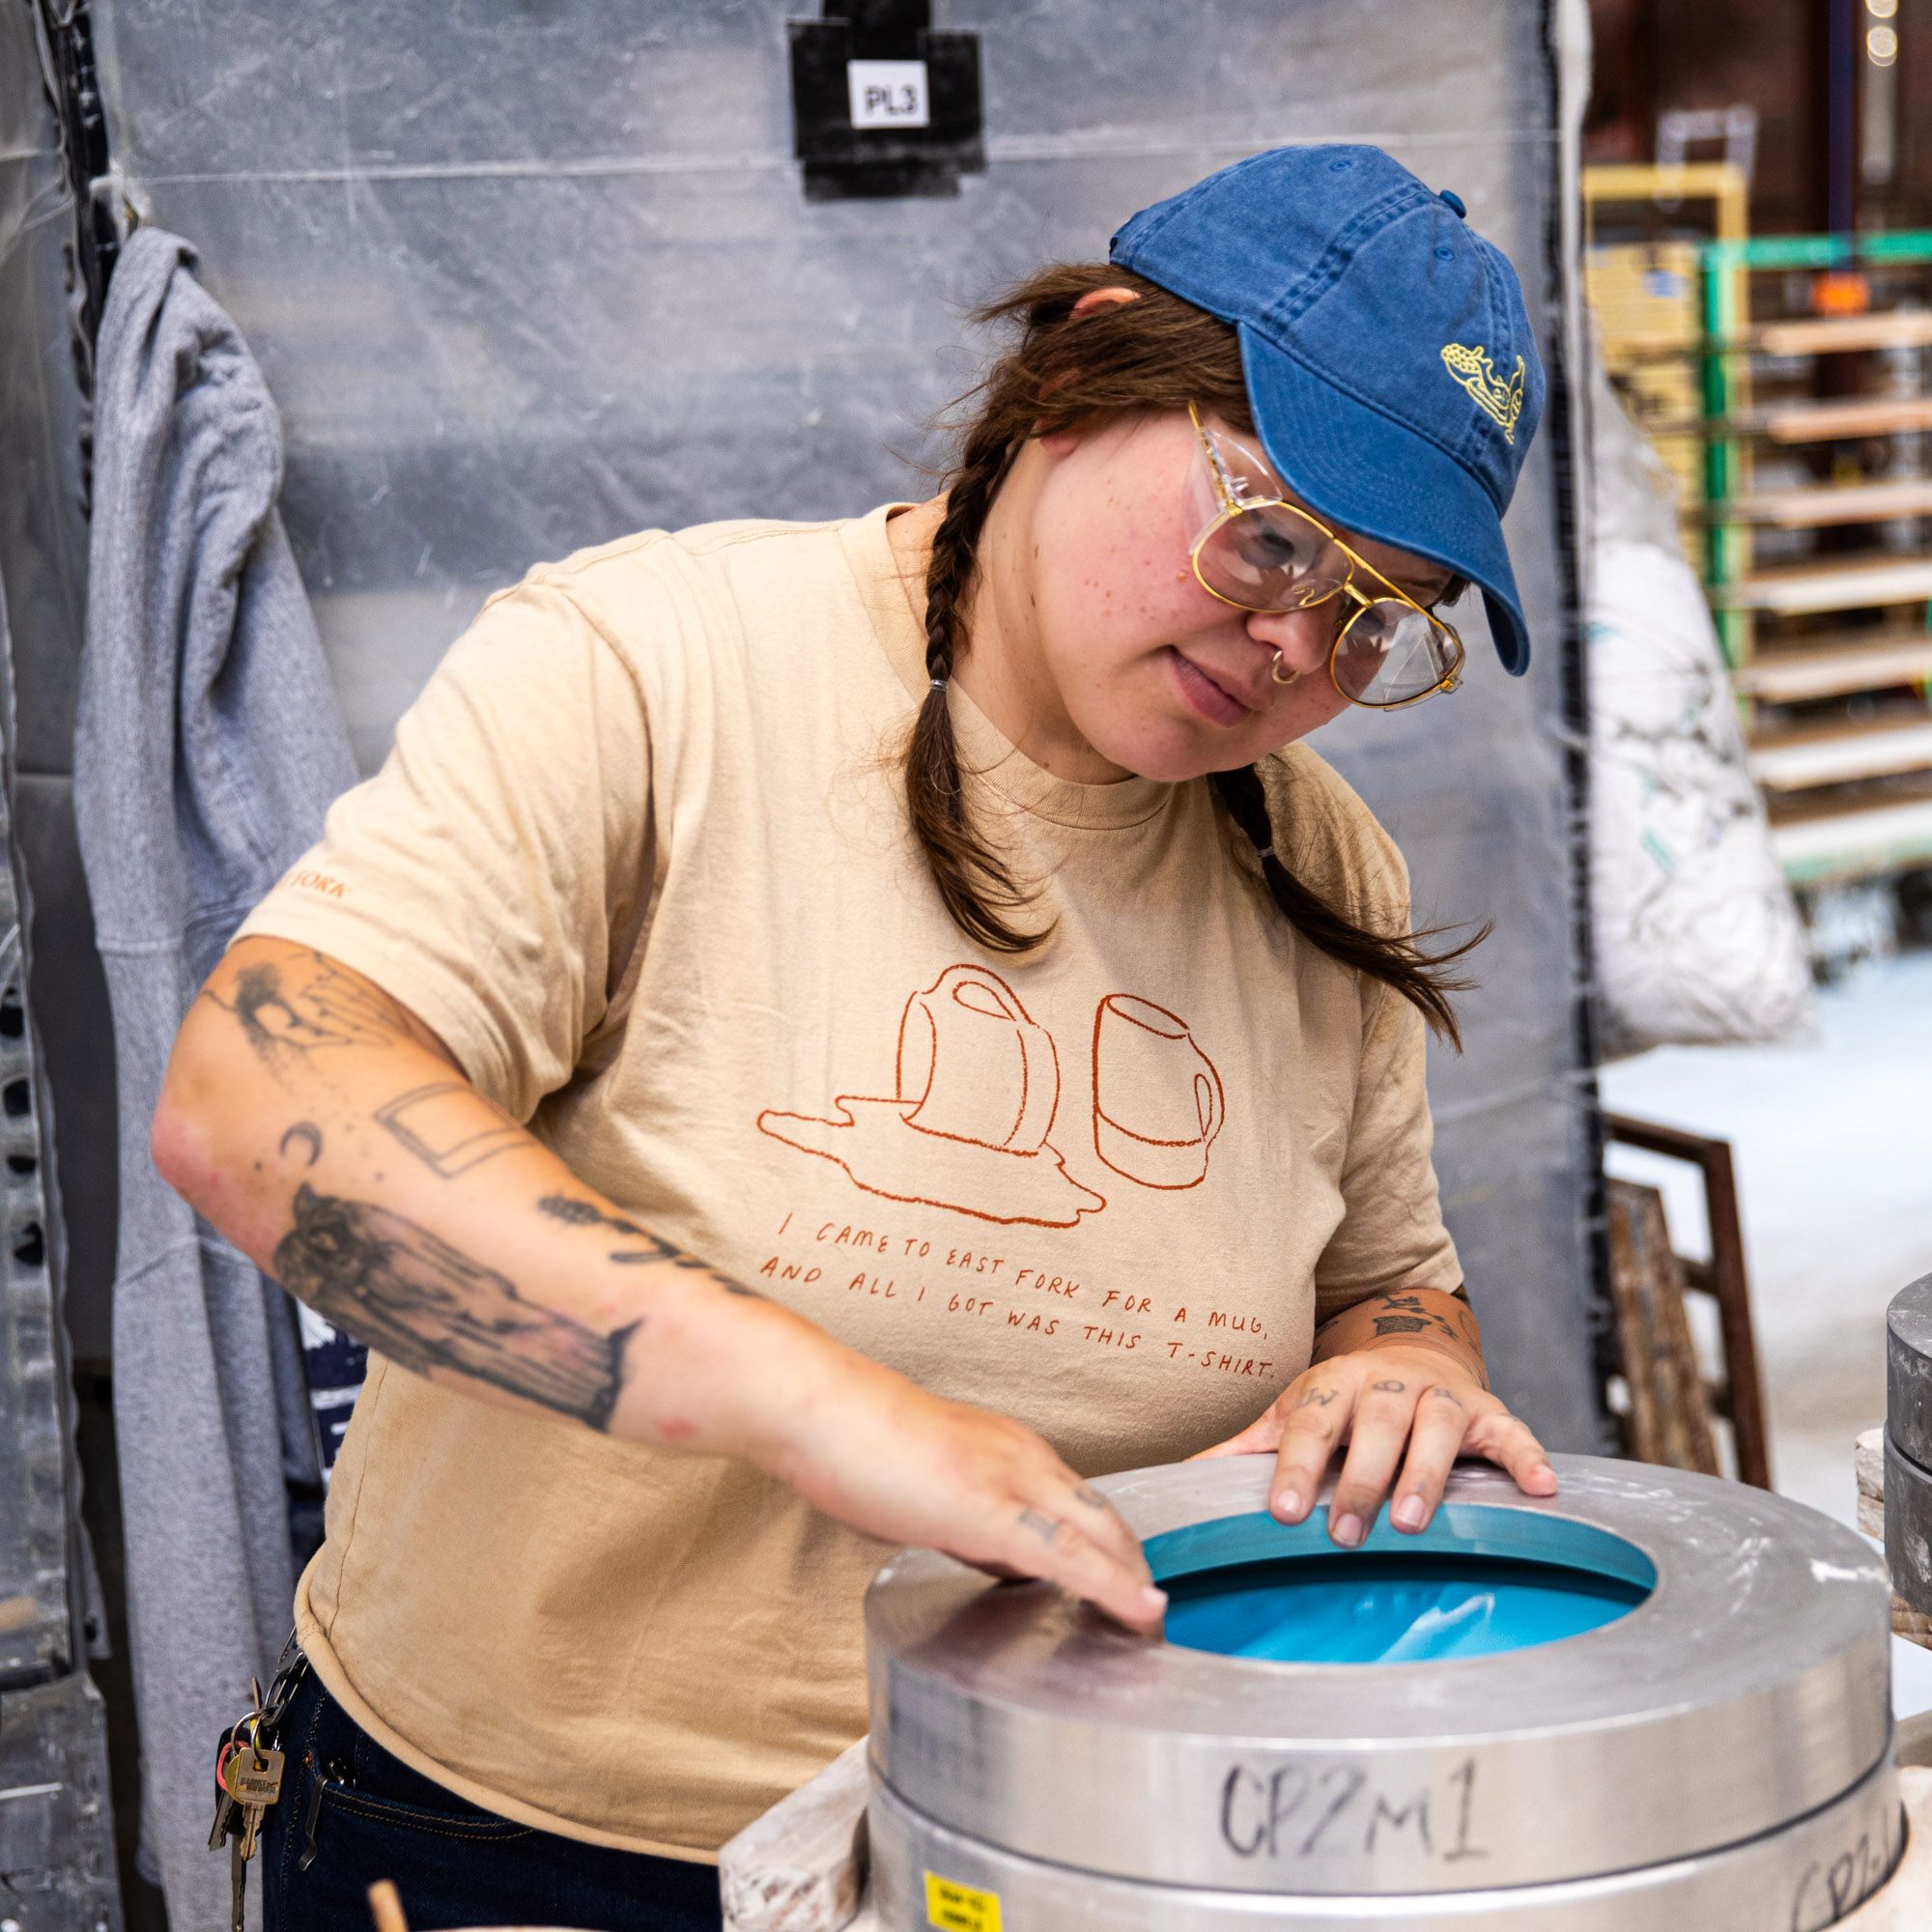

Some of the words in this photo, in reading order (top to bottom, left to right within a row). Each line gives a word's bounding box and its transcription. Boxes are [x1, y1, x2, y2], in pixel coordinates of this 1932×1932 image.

[865, 84, 918, 116] PL3
[759, 1256, 823, 1284] AND
[848, 1271, 896, 1298] ALL
[917, 1286, 926, 1303] I
[948, 1293, 994, 1317] GOT
[1007, 1310, 1060, 1336] WAS
[1083, 1324, 1142, 1350] THIS
[1167, 1342, 1274, 1379] T-SHIRT.
[778, 1210, 794, 1236] I
[815, 1222, 890, 1254] CAME
[904, 1237, 931, 1258] TO
[946, 1249, 1006, 1274] EAST
[1015, 1268, 1080, 1298] FORK
[1102, 1290, 1152, 1314] FOR
[1174, 1306, 1187, 1323] A
[1208, 1311, 1267, 1341] MUG,
